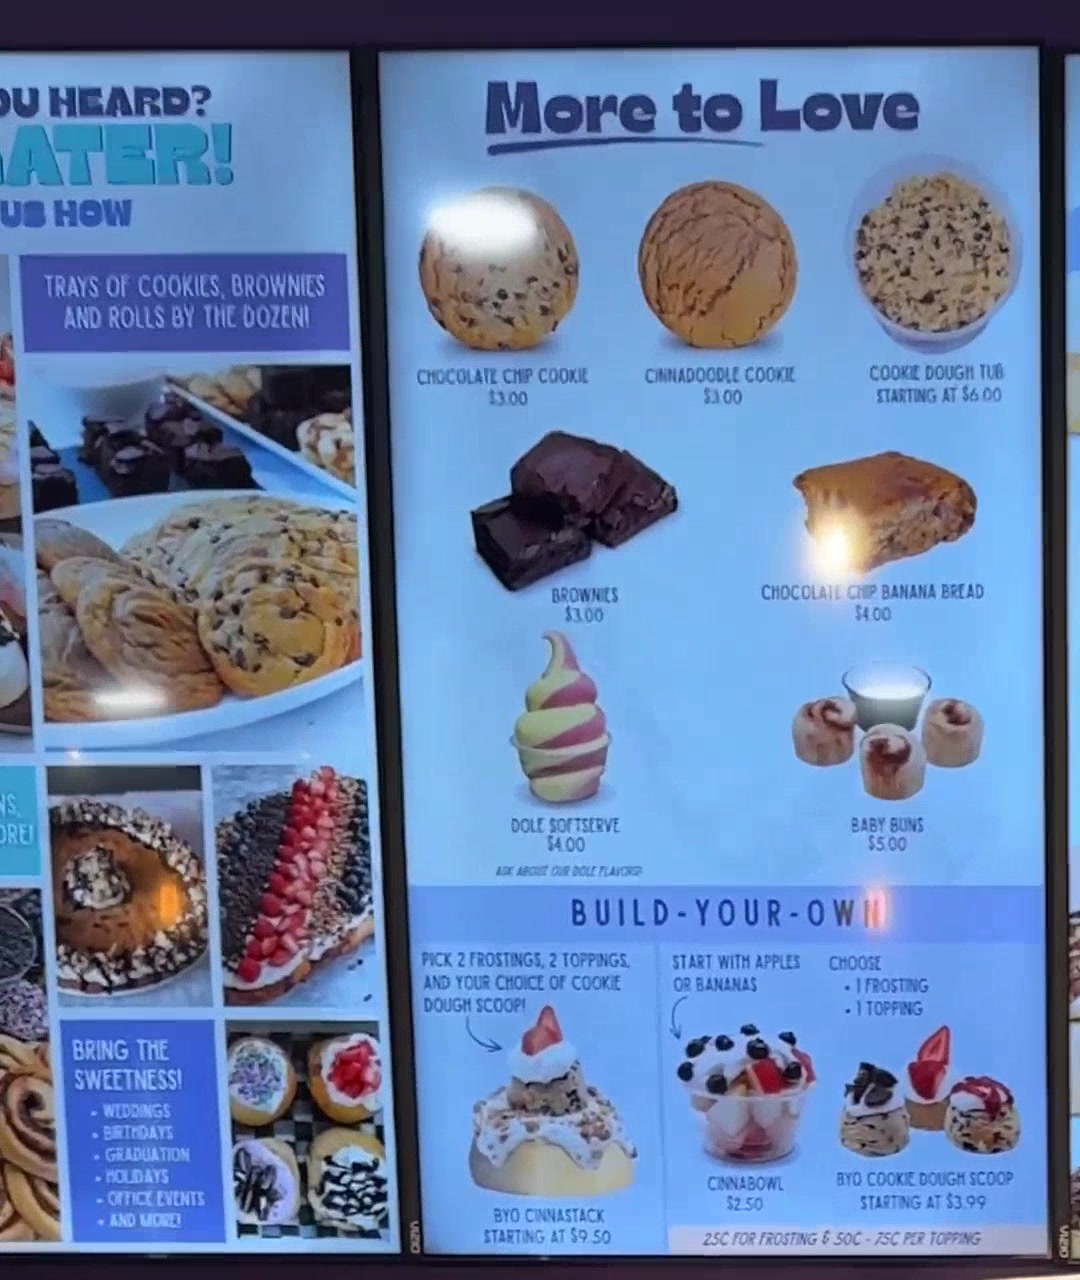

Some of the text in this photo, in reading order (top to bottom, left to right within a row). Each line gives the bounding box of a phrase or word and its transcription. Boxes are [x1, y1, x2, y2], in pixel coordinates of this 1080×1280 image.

[49, 86, 212, 119] HEARD?
[485, 79, 919, 133] More to Love
[0, 122, 235, 186] ATER!
[53, 199, 133, 228] HOW
[45, 275, 324, 298] TRAYS OF COOKIES, BROWNIES
[64, 305, 309, 329] AND ROLLS BY THE DOZEN!
[417, 367, 588, 385] CHOCOLATE CHIP COOKIE
[645, 366, 794, 384] CINNADOODLE COOKIE
[870, 364, 1004, 382] COOKIE DOUGH TUB
[489, 390, 528, 408] $3.00
[704, 388, 742, 405] $3.00
[877, 386, 1002, 404] STARTING AT $6.00
[552, 587, 618, 604] BROWNIES
[565, 606, 603, 623] $3.00
[855, 605, 891, 623] $4.00
[511, 817, 620, 835] DOLE SOFTSERVE
[851, 816, 883, 834] BABY
[547, 836, 585, 853] $4.00
[868, 835, 906, 852] $5.00
[423, 952, 630, 971] PICK 2 FROSTINGS, 2 TOPPINGS,
[829, 954, 881, 972] CHOOSE
[73, 1039, 168, 1062] BRING THE
[75, 1069, 182, 1092] SWEETNESS!
[104, 1104, 170, 1120] WEDDINGS
[106, 1147, 189, 1163] GRADUATION
[708, 1176, 783, 1193] CINNABOWL
[108, 1191, 205, 1207] OFFICE EVENTS
[727, 1196, 763, 1212] $2.50
[860, 1194, 986, 1211] STARTING AT $3.99
[494, 1207, 604, 1224] BYO CINNASTACK
[703, 1231, 729, 1247] 25C
[733, 1231, 754, 1247] FOR
[759, 1231, 816, 1247] FROSTING
[834, 1231, 859, 1247] 50C
[875, 1231, 900, 1247] 75C
[904, 1231, 924, 1247] PER
[927, 1231, 981, 1247] TOPPING
